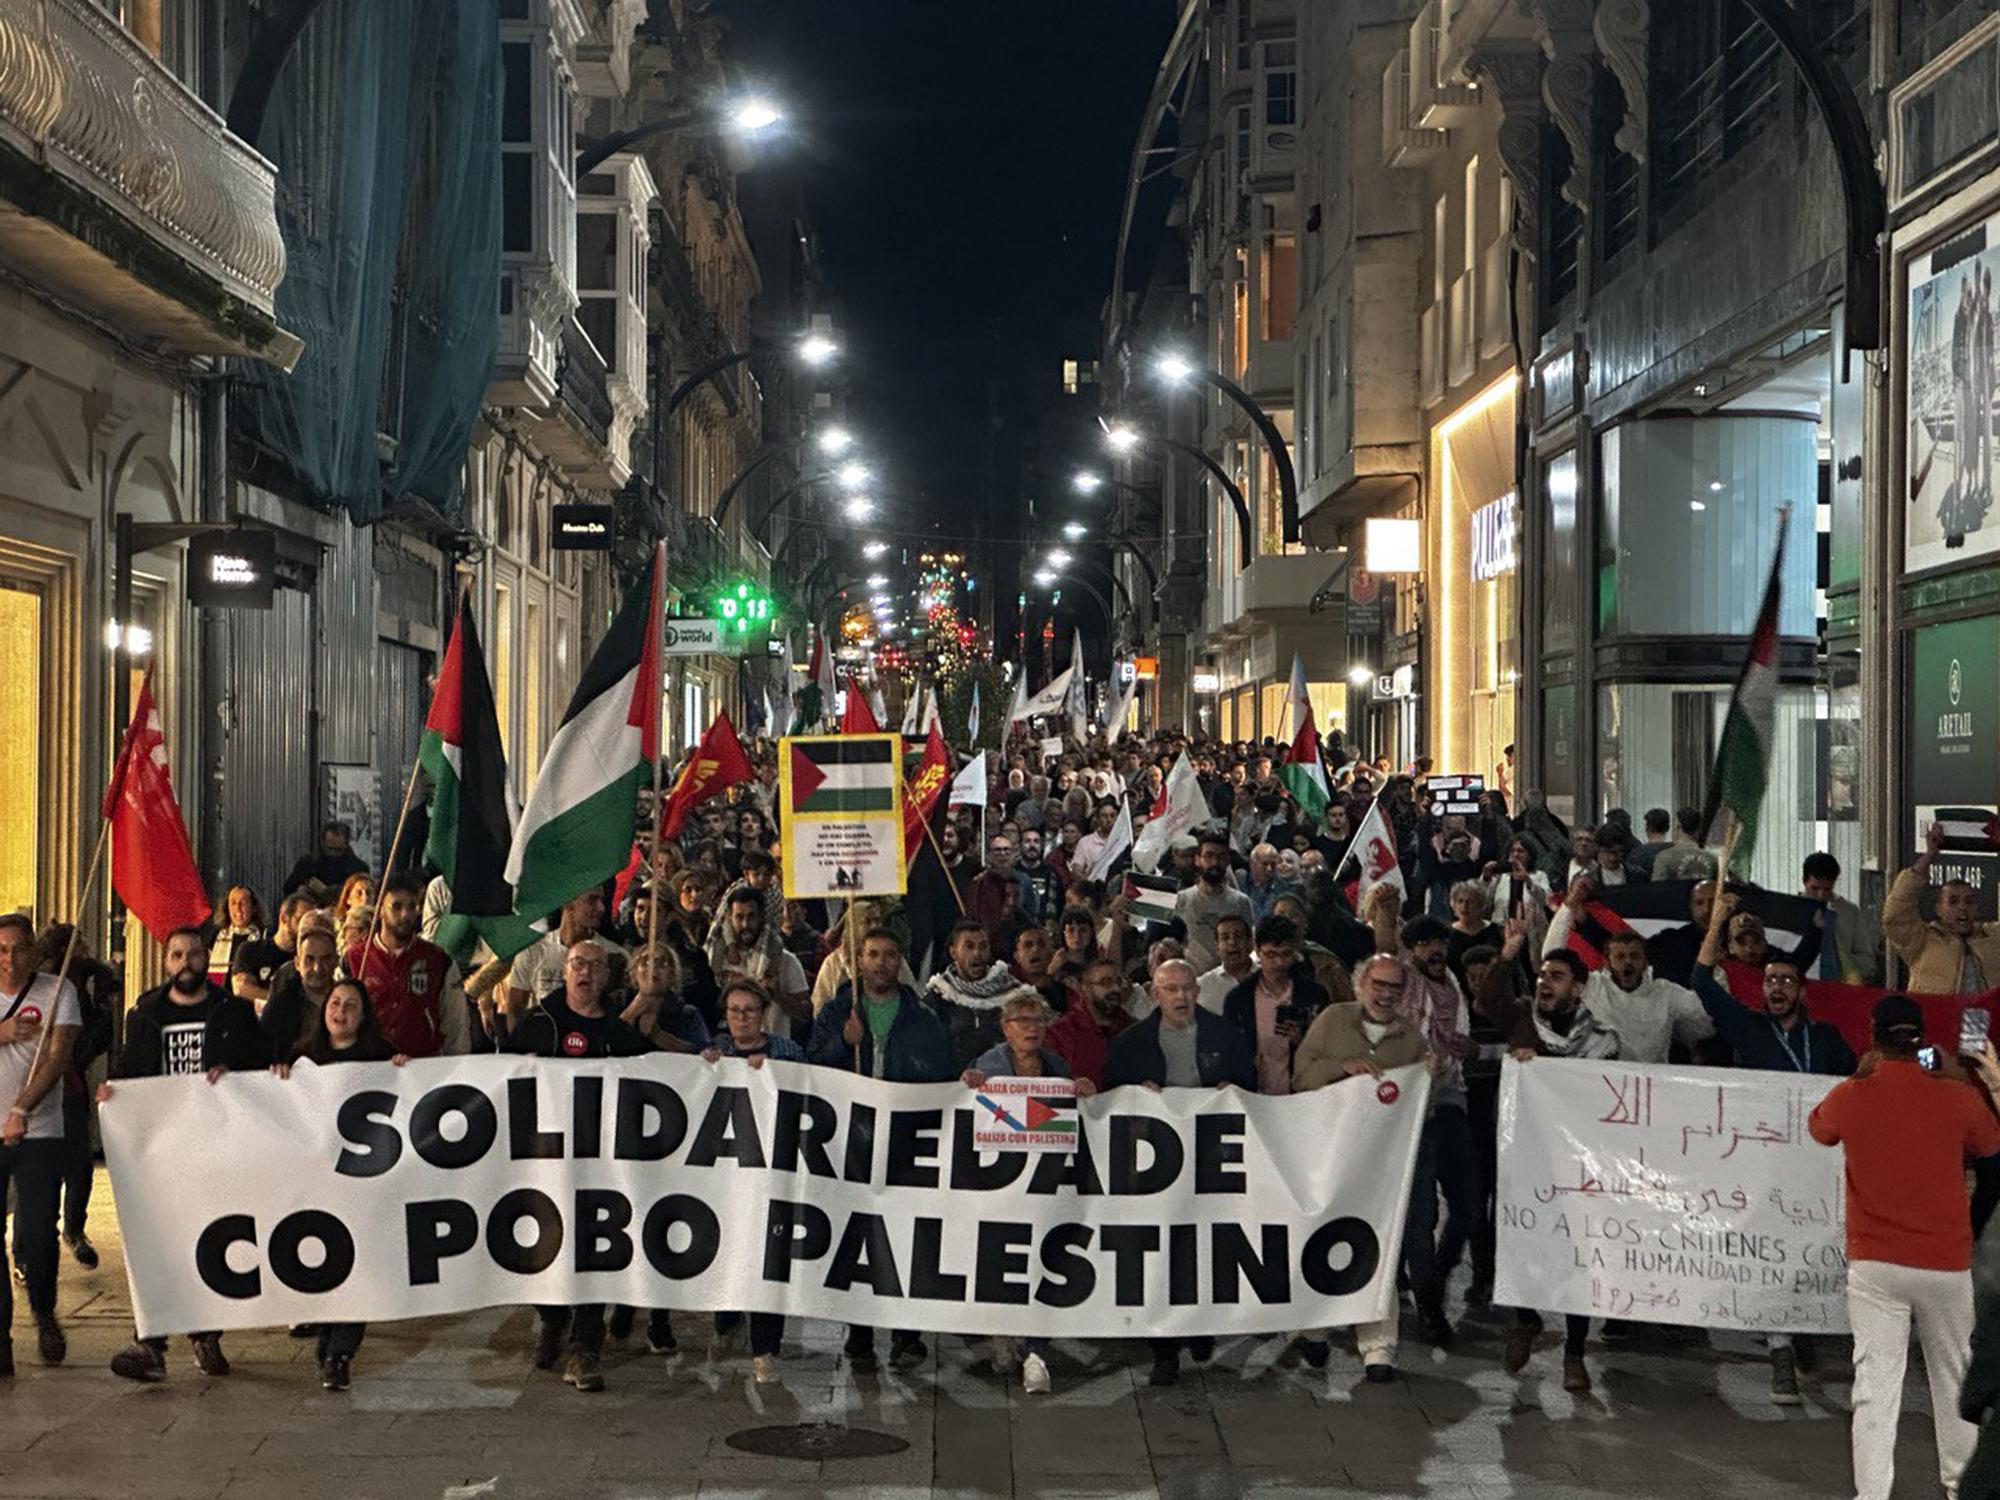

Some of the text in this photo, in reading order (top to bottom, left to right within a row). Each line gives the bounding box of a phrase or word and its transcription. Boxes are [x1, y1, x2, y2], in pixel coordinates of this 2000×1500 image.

[681, 631, 713, 644] world
[335, 1077, 1247, 1196] SOLIDARIEDADE
[1008, 1133, 1028, 1143] CON
[1029, 1133, 1076, 1144] PALESTINA
[1502, 1204, 1536, 1230] NO
[1552, 1211, 1572, 1239] A
[1584, 1213, 1643, 1245] LOS
[196, 1189, 1380, 1308] CO POBO PALESTINO
[1573, 1245, 1606, 1269] LA
